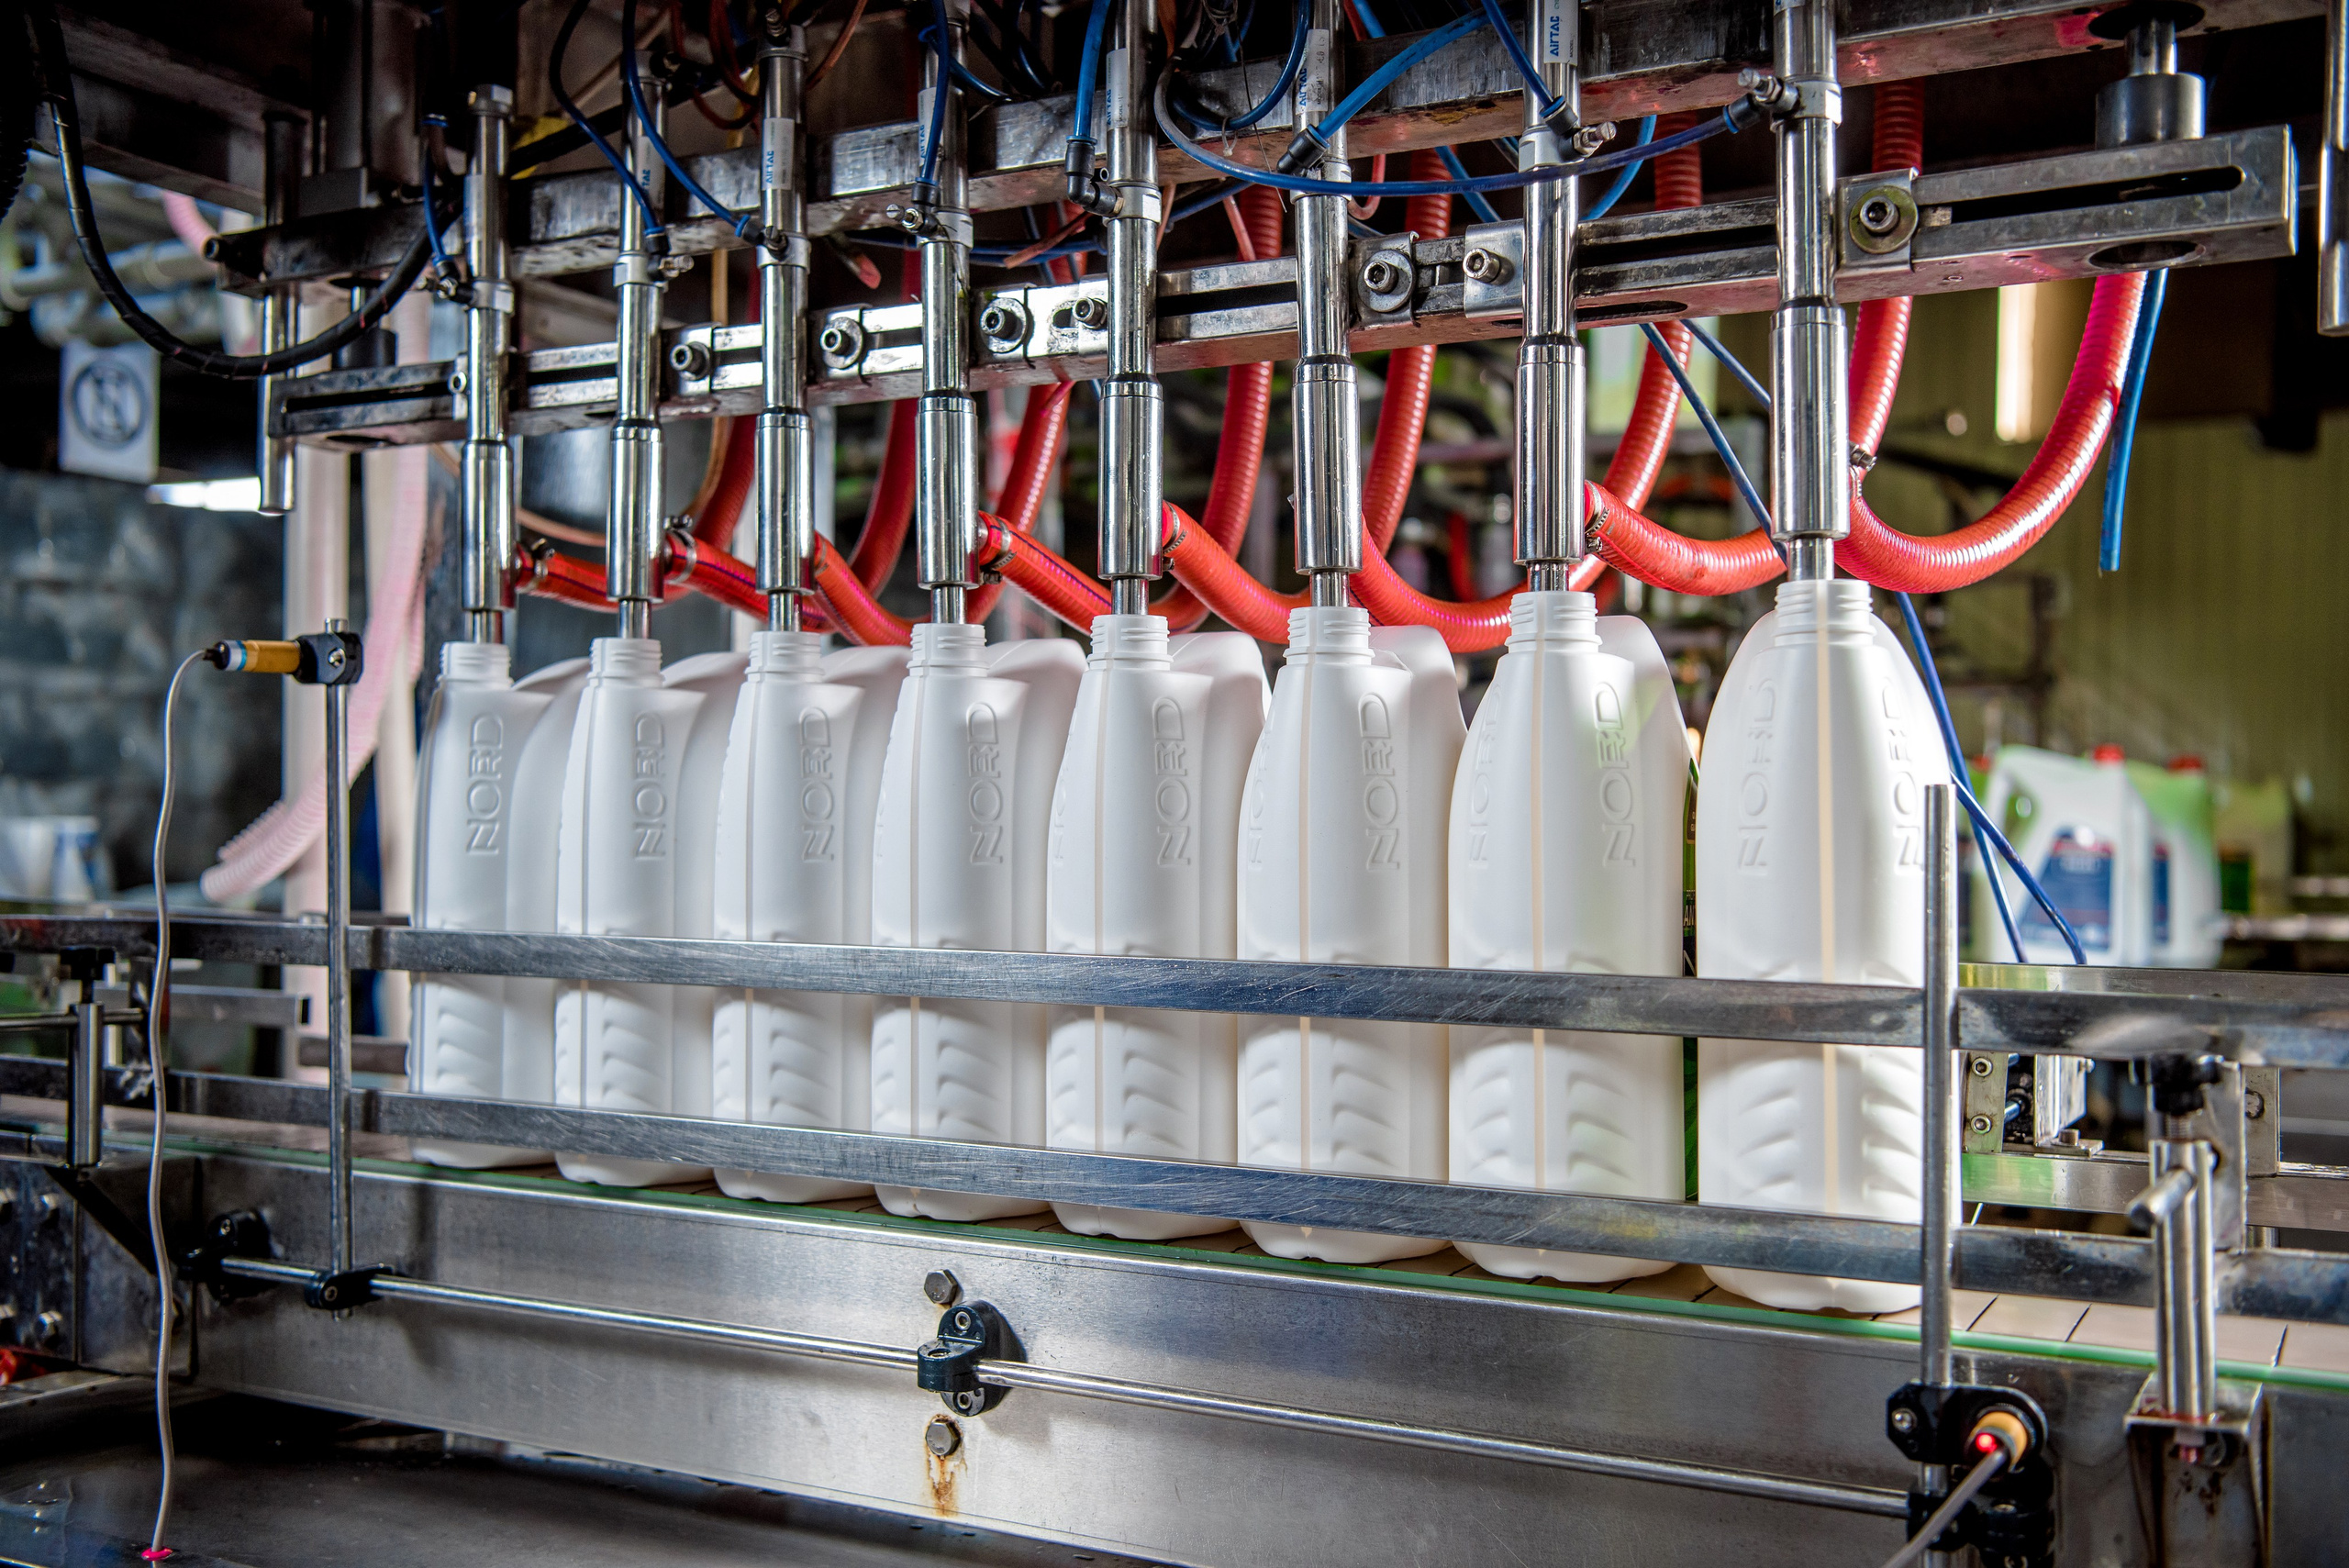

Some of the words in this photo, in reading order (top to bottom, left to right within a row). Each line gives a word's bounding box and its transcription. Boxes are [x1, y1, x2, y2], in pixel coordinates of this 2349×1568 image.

[466, 711, 504, 855] NORD
[632, 711, 666, 861] NORD
[799, 706, 834, 863] NORD
[966, 702, 1004, 864] NORD
[1152, 696, 1191, 867] NORD
[1358, 692, 1400, 870] NORD
[1592, 681, 1637, 868] NORD
